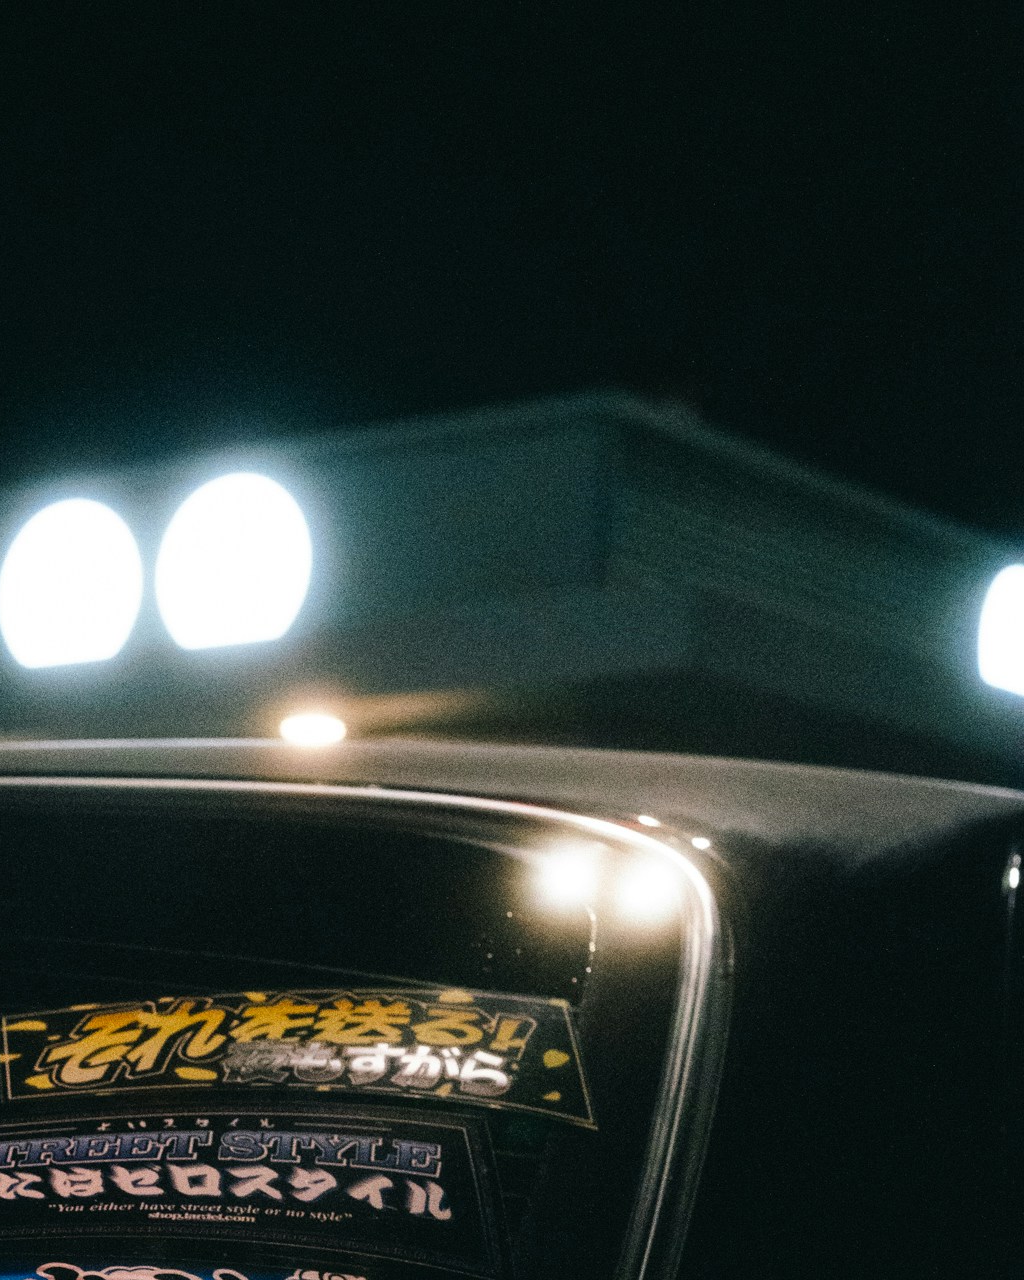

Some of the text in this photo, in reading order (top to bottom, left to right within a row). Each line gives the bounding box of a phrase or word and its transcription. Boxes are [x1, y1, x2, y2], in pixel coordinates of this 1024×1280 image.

[219, 1130, 444, 1178] STYLE
[89, 1202, 134, 1212] either
[139, 1201, 175, 1211] have
[180, 1202, 221, 1213] street
[226, 1204, 260, 1215] style
[265, 1207, 281, 1216] or
[286, 1208, 305, 1218] no
